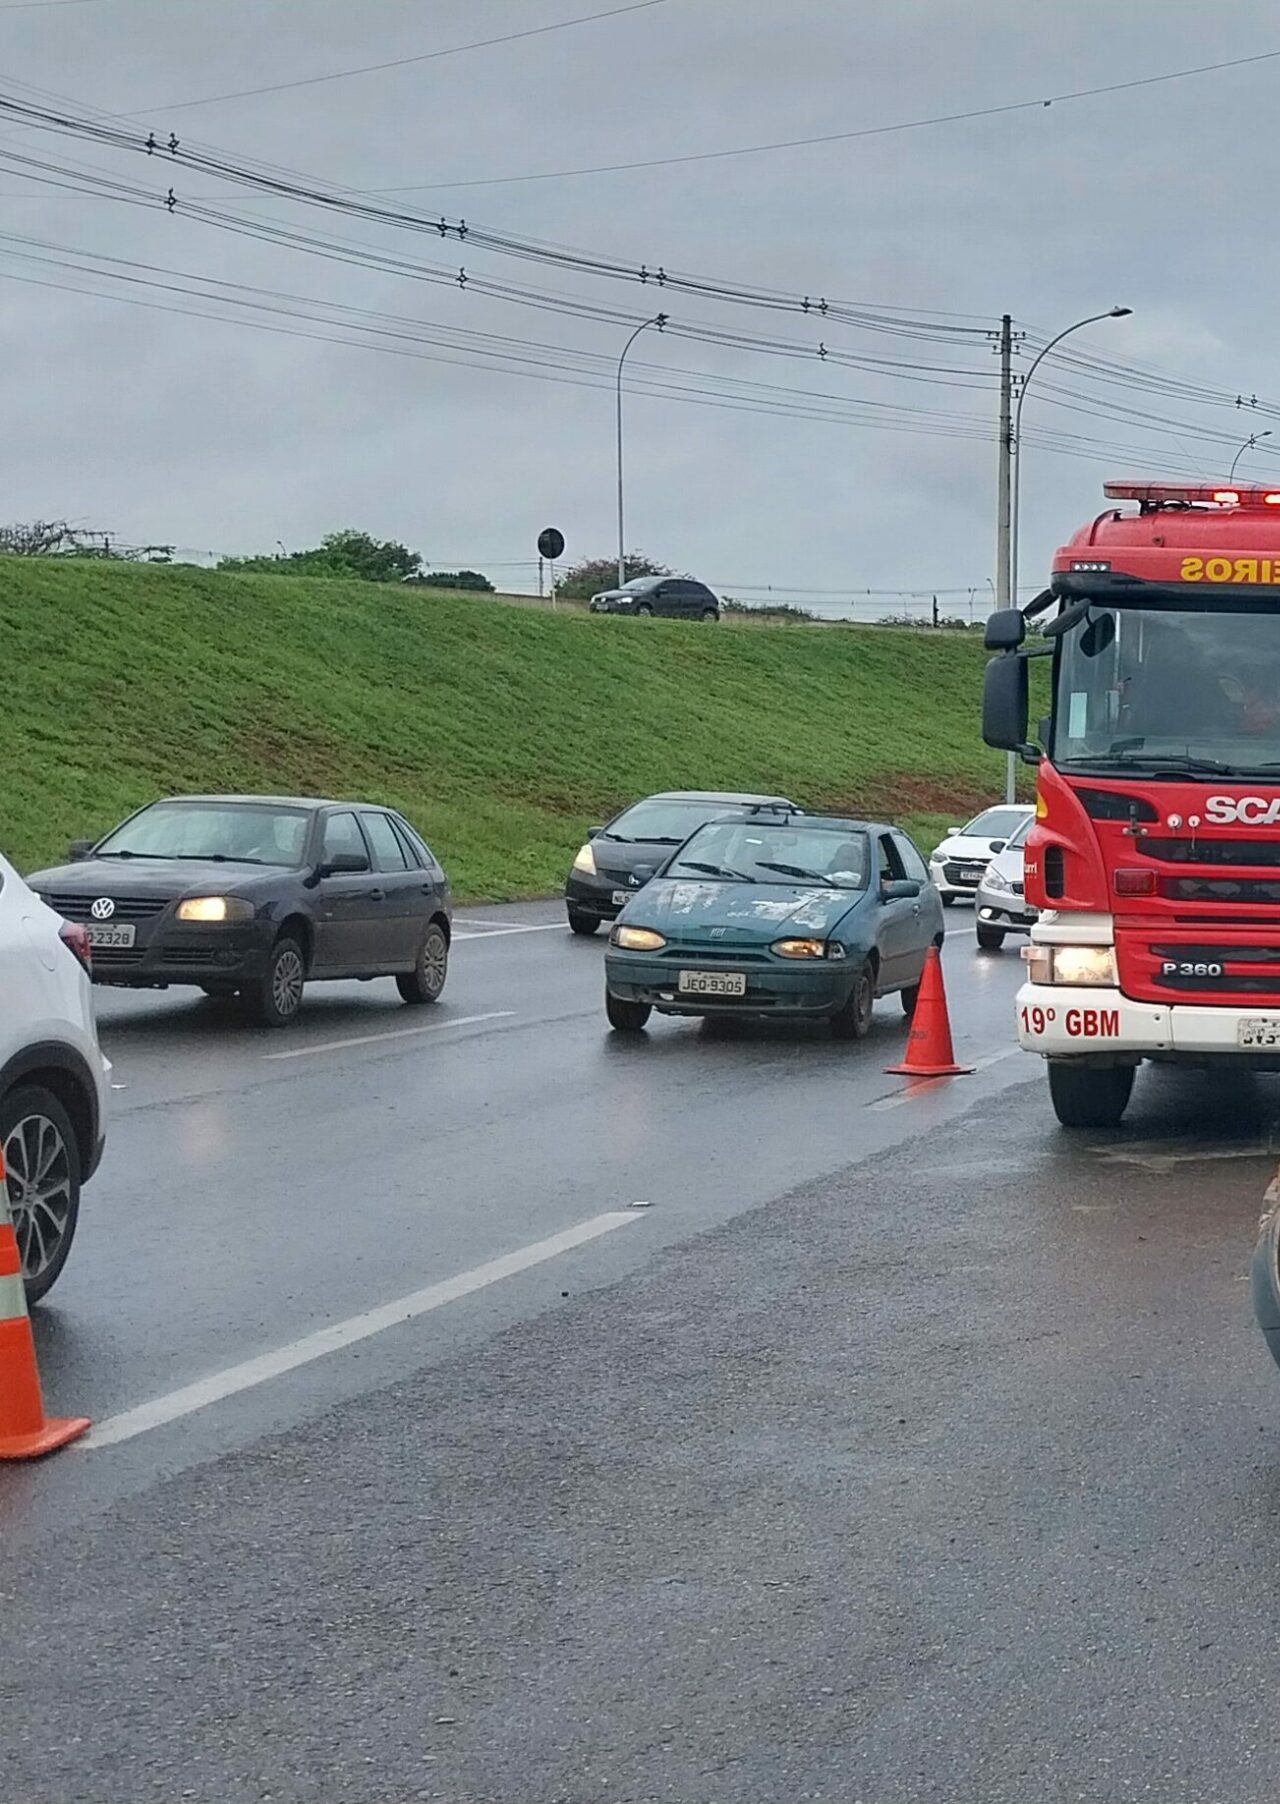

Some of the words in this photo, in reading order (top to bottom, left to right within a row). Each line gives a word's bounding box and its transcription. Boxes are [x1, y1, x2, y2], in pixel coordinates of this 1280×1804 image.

[1163, 963, 1177, 976] P
[1179, 963, 1222, 977] 360
[1065, 1009, 1120, 1037] GBM
